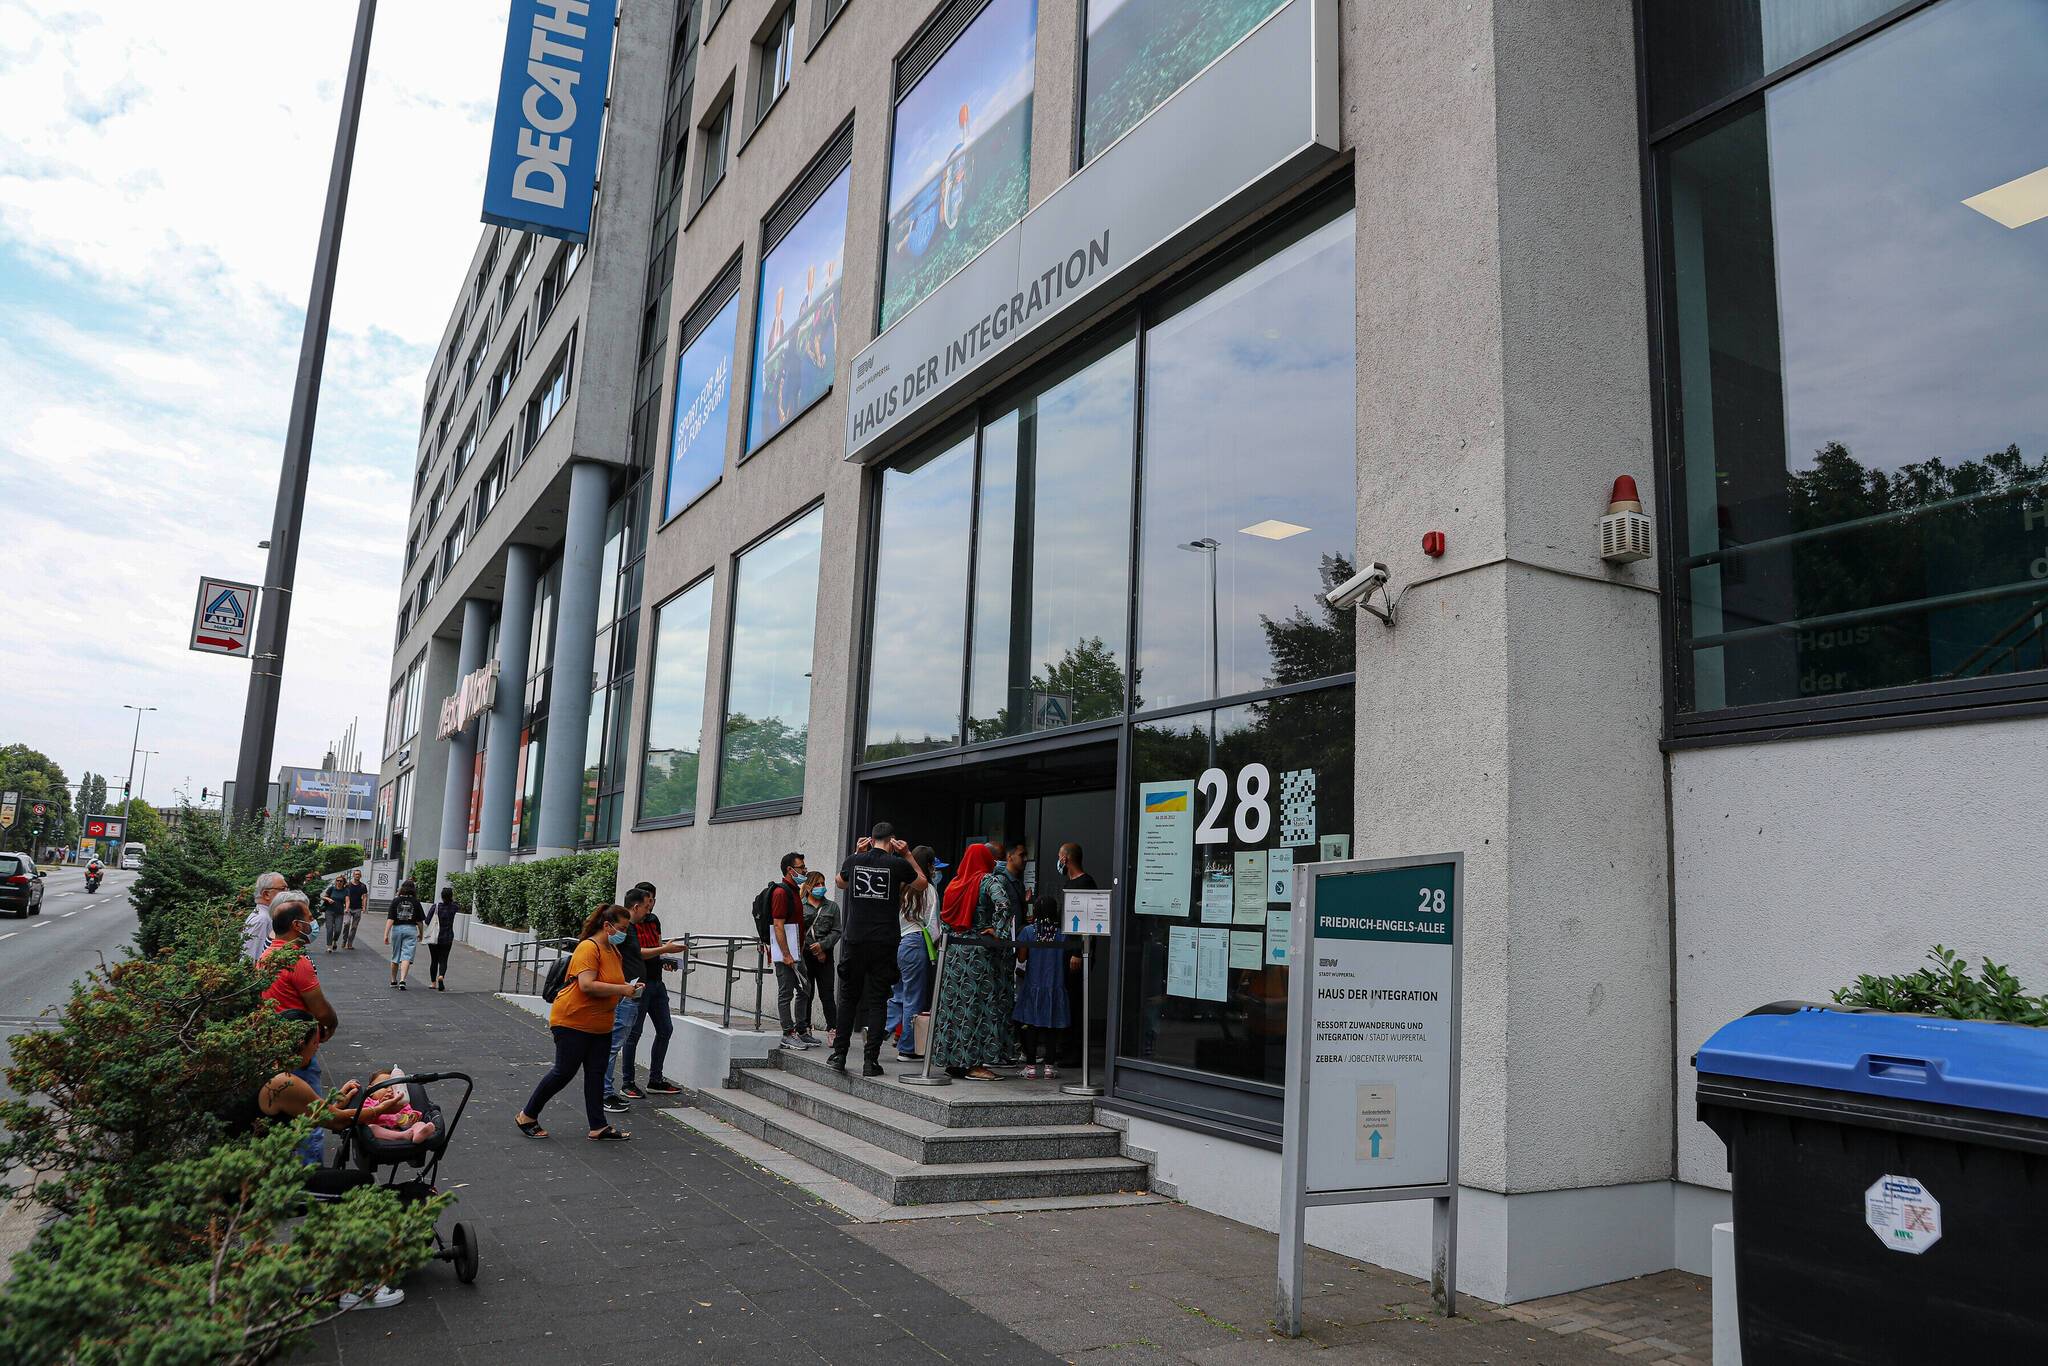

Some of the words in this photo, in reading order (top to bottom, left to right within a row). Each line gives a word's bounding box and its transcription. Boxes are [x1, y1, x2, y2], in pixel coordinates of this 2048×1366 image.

[852, 385, 898, 442] HAUS
[903, 354, 938, 408] DER
[944, 228, 1110, 377] INTEGRATION
[678, 396, 700, 442] SPORT
[700, 376, 713, 408] FOR
[714, 355, 727, 386] ALL
[675, 434, 688, 464] ALL
[688, 414, 702, 445] FOR
[702, 376, 727, 425] SPORT
[208, 615, 240, 627] ALDI
[1797, 626, 1871, 653] Haus
[1799, 668, 1848, 693] der
[1195, 762, 1272, 845] 28
[1418, 887, 1446, 914] 28
[1320, 916, 1446, 934] FRIEDRICH-ENGELS-ALLEE
[1318, 988, 1345, 999] HAUS
[1348, 989, 1368, 1000] DER
[1371, 990, 1438, 1002] INTEGRATION
[1316, 1021, 1347, 1029] RESSORT
[1349, 1021, 1406, 1030] ZUWANDERUNG
[1316, 1033, 1364, 1041] INTEGRATION
